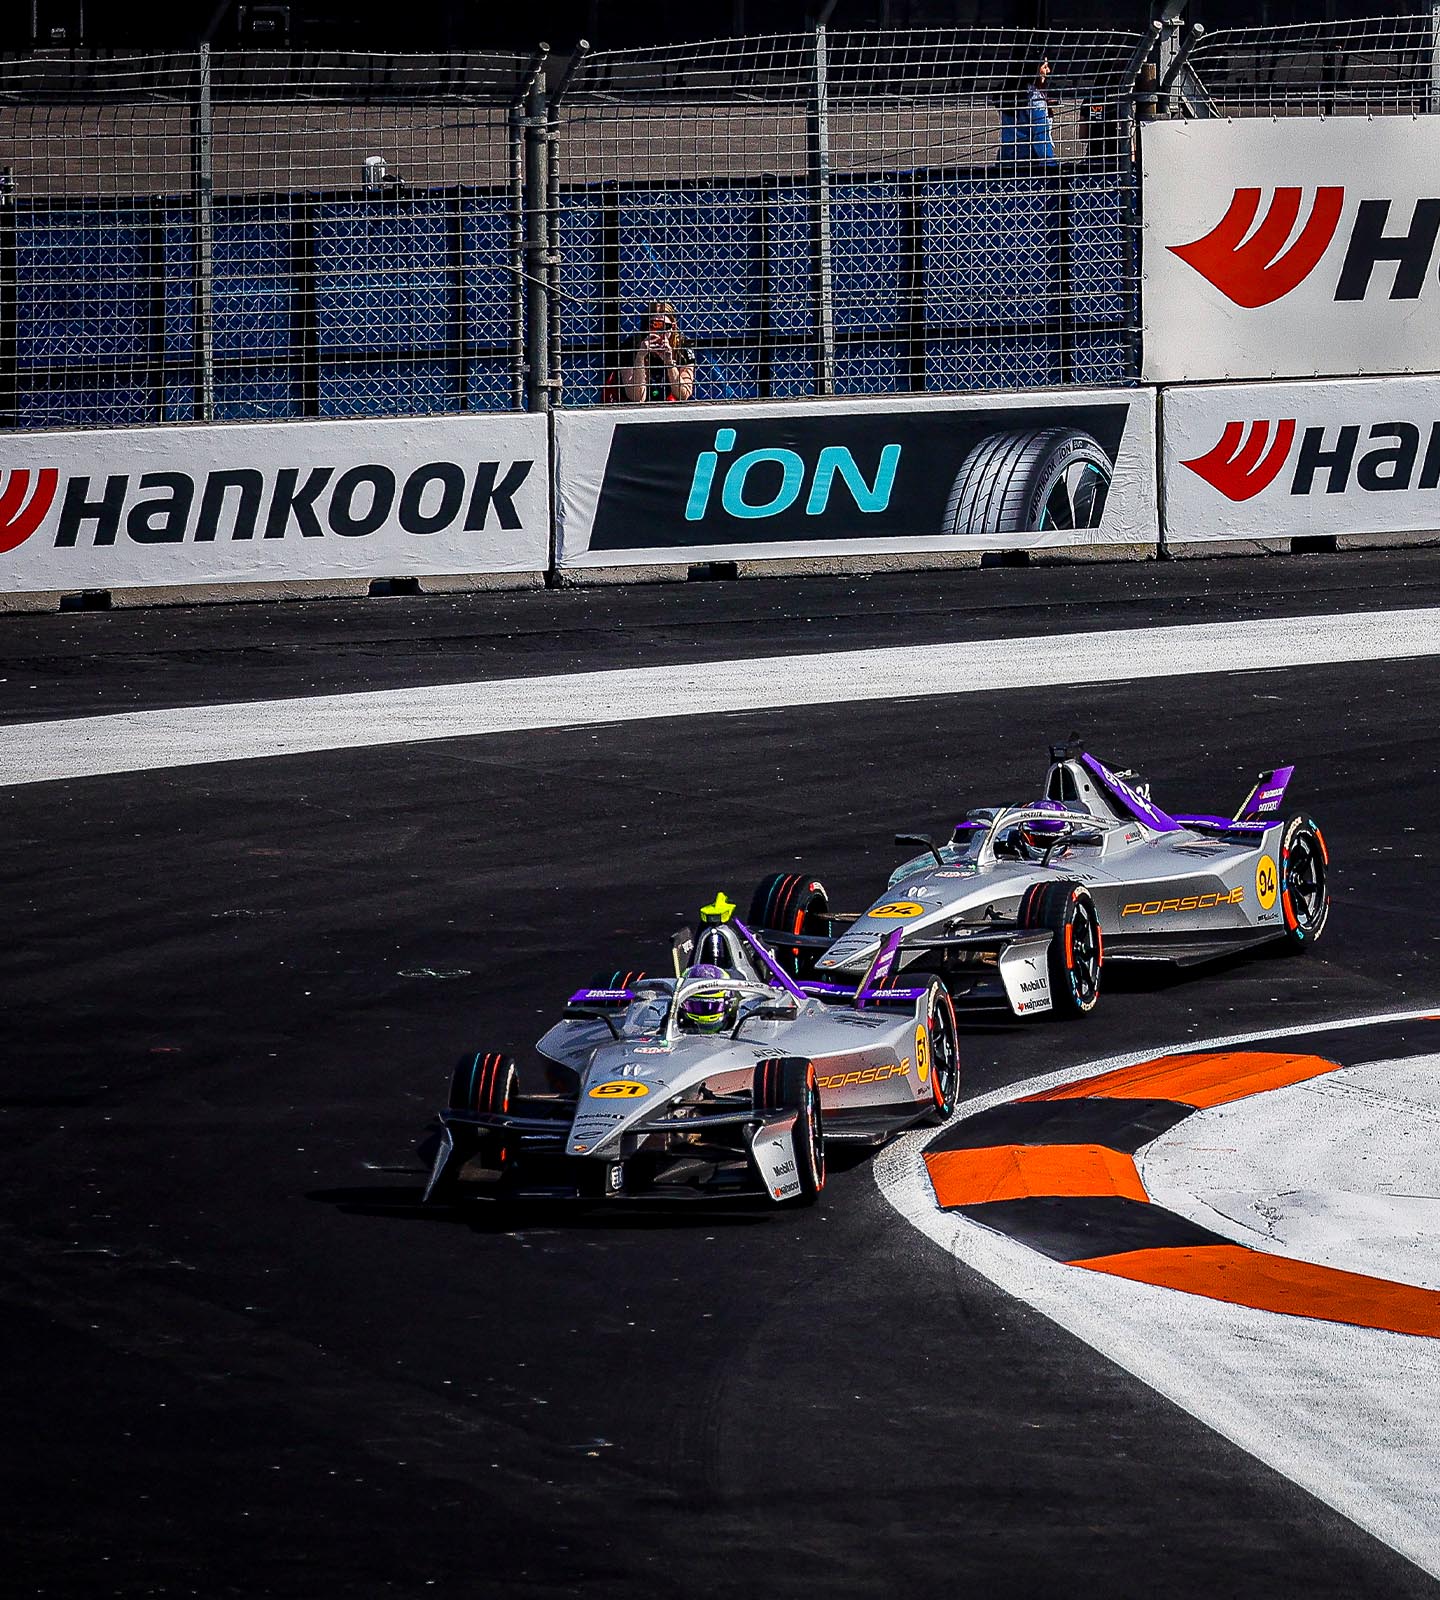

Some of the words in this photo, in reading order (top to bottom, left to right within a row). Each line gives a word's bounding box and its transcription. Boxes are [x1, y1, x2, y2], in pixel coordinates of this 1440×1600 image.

[1259, 873, 1274, 896] 94
[1121, 887, 1245, 917] PORSCHE
[1020, 979, 1040, 993] Mobil
[816, 1057, 911, 1089] PORSCHE
[597, 1085, 641, 1095] 51
